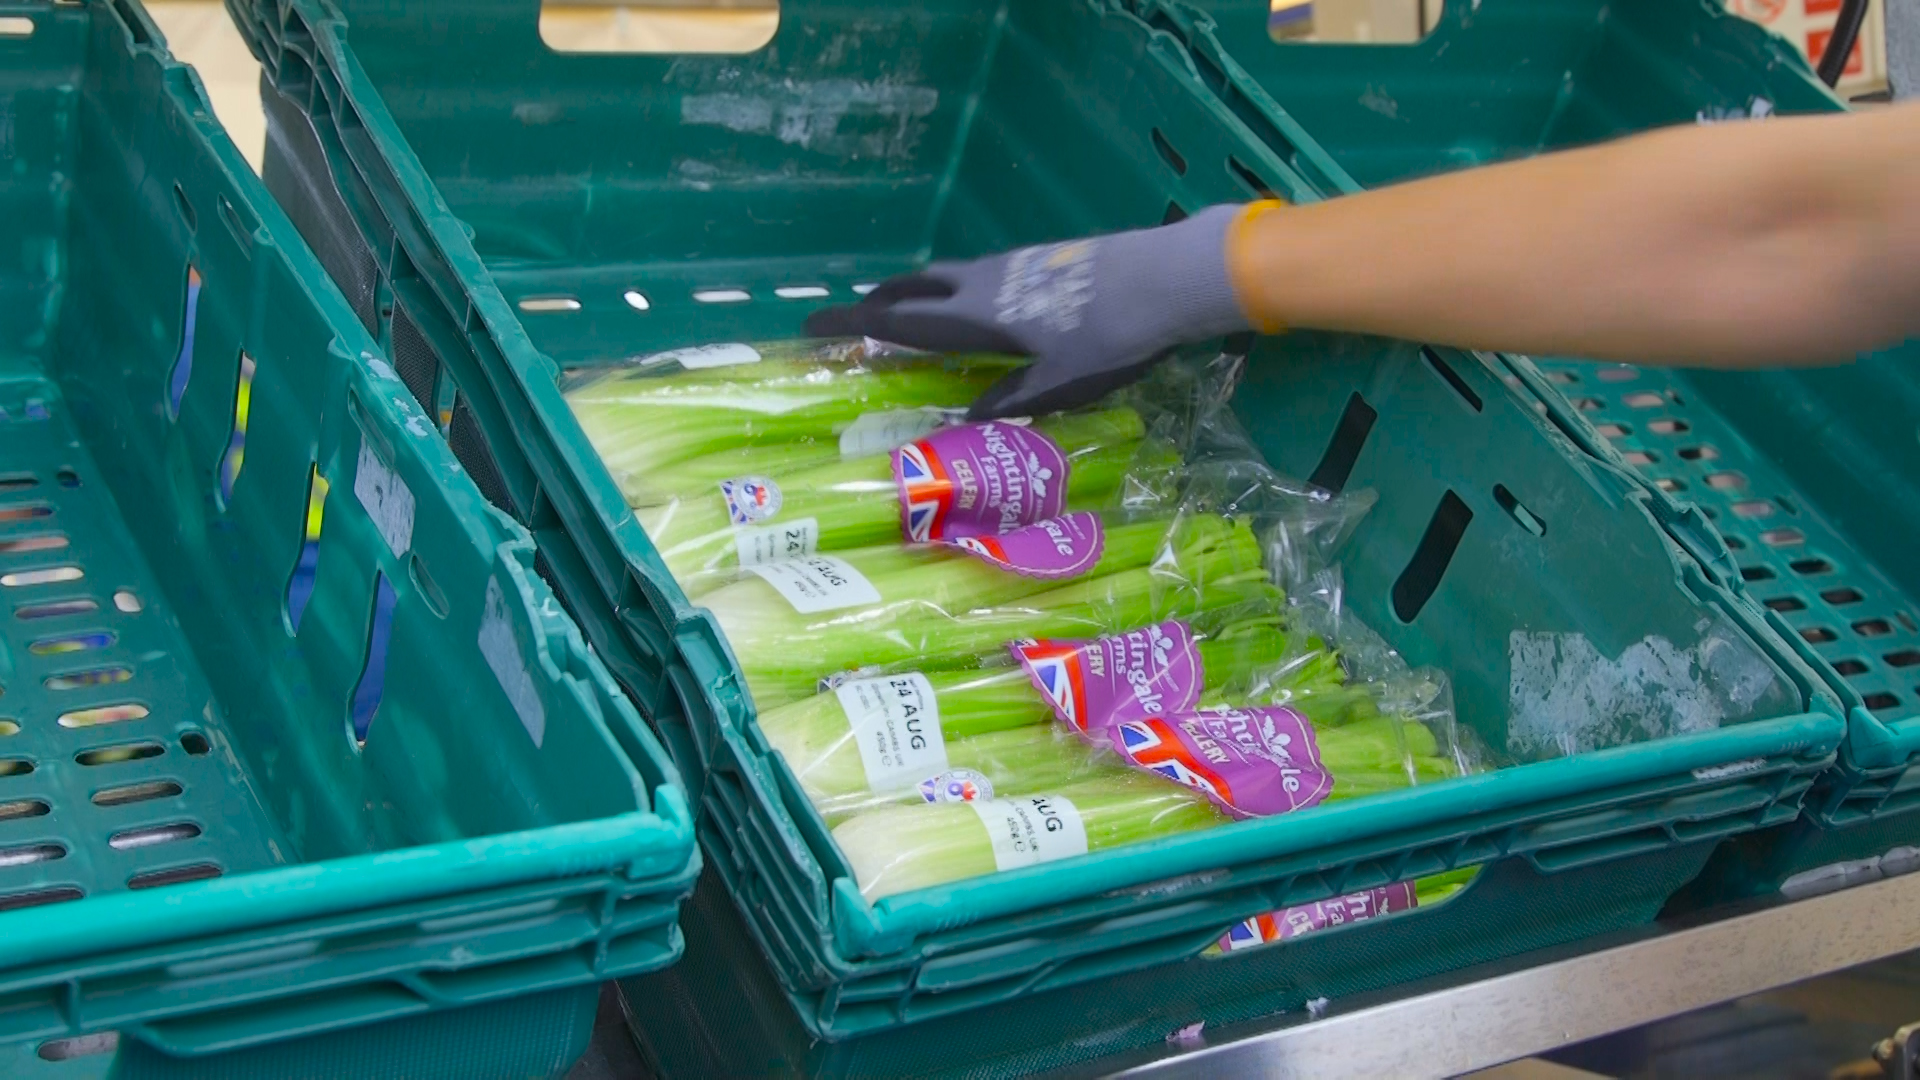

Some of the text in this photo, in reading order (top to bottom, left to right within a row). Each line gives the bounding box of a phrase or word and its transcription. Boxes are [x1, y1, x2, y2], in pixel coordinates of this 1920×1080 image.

[952, 459, 978, 510] CELERY
[981, 456, 1002, 508] Farms
[890, 679, 913, 699] 24
[903, 703, 927, 751] AUG
